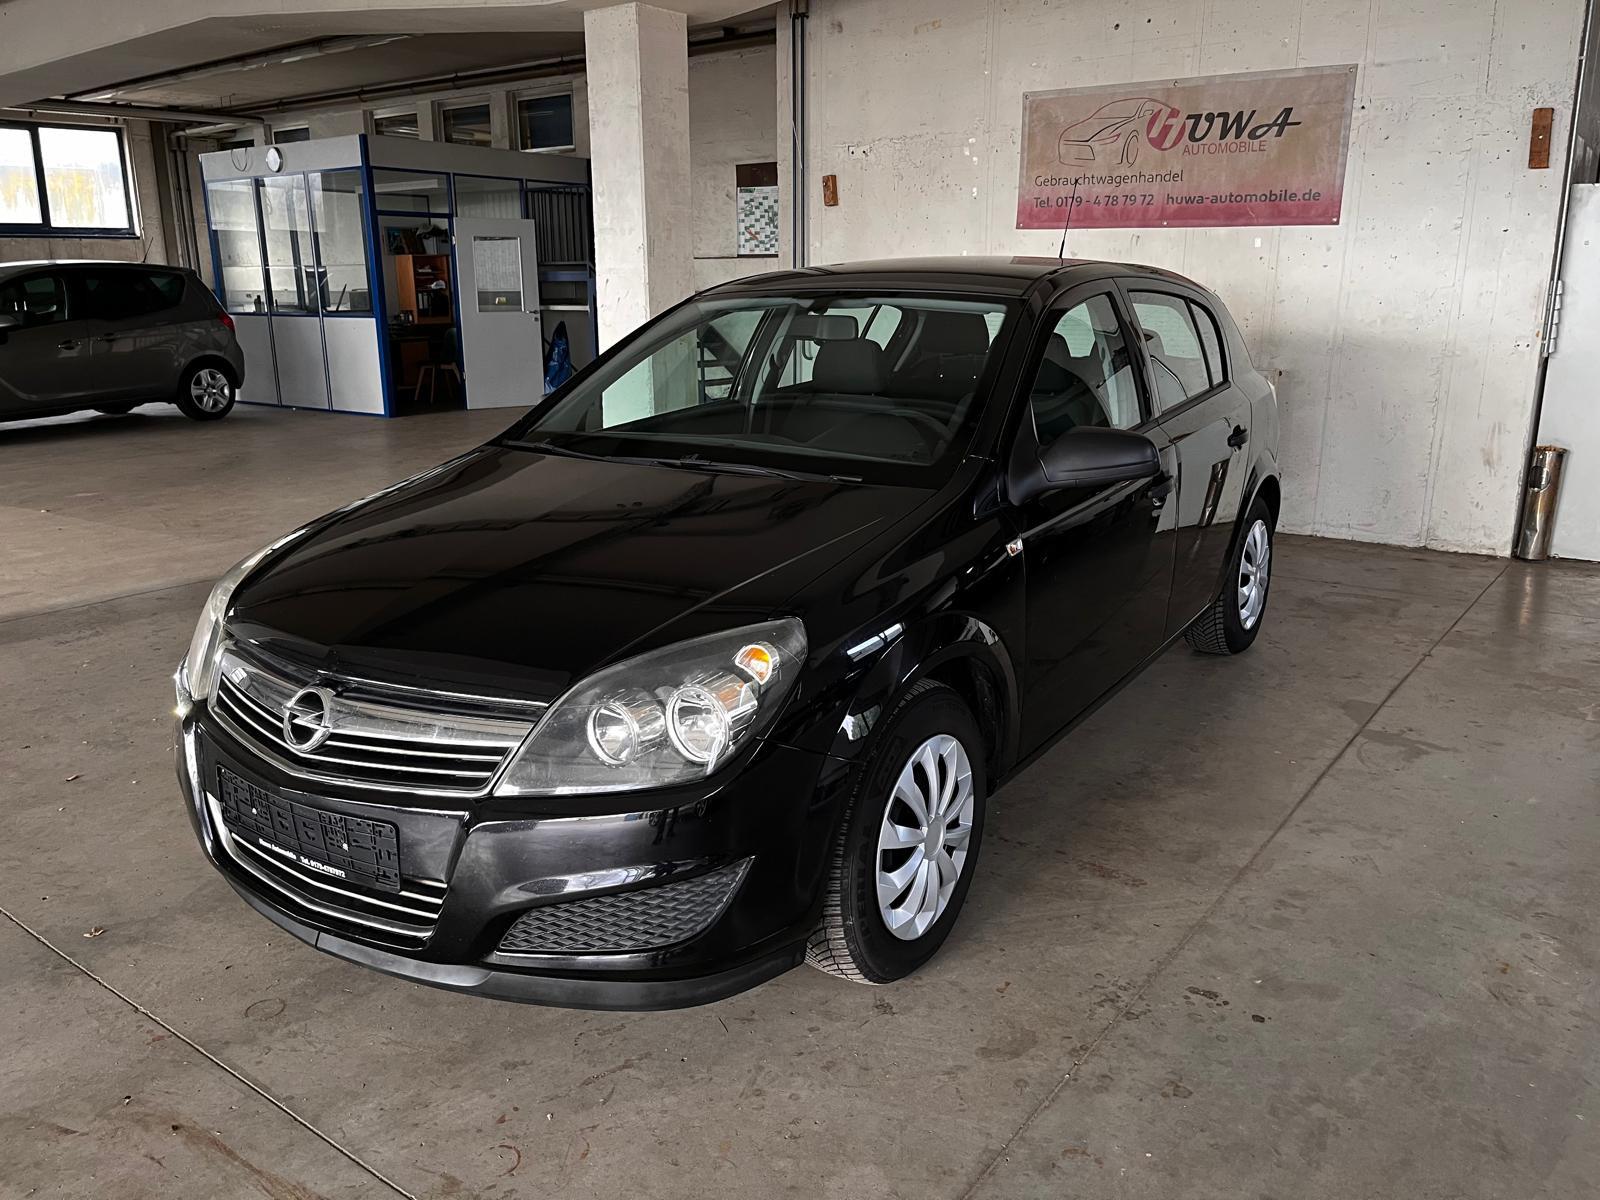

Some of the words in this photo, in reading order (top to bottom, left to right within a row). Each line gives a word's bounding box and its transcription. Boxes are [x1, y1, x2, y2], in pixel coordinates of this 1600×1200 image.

[1182, 140, 1267, 156] AUTOMOBILE
[1034, 170, 1184, 187] Gebrauchtwagenhandel
[1034, 196, 1053, 208] Tel.
[1056, 195, 1083, 207] 0179
[1166, 188, 1322, 205] huwa-automobile.de
